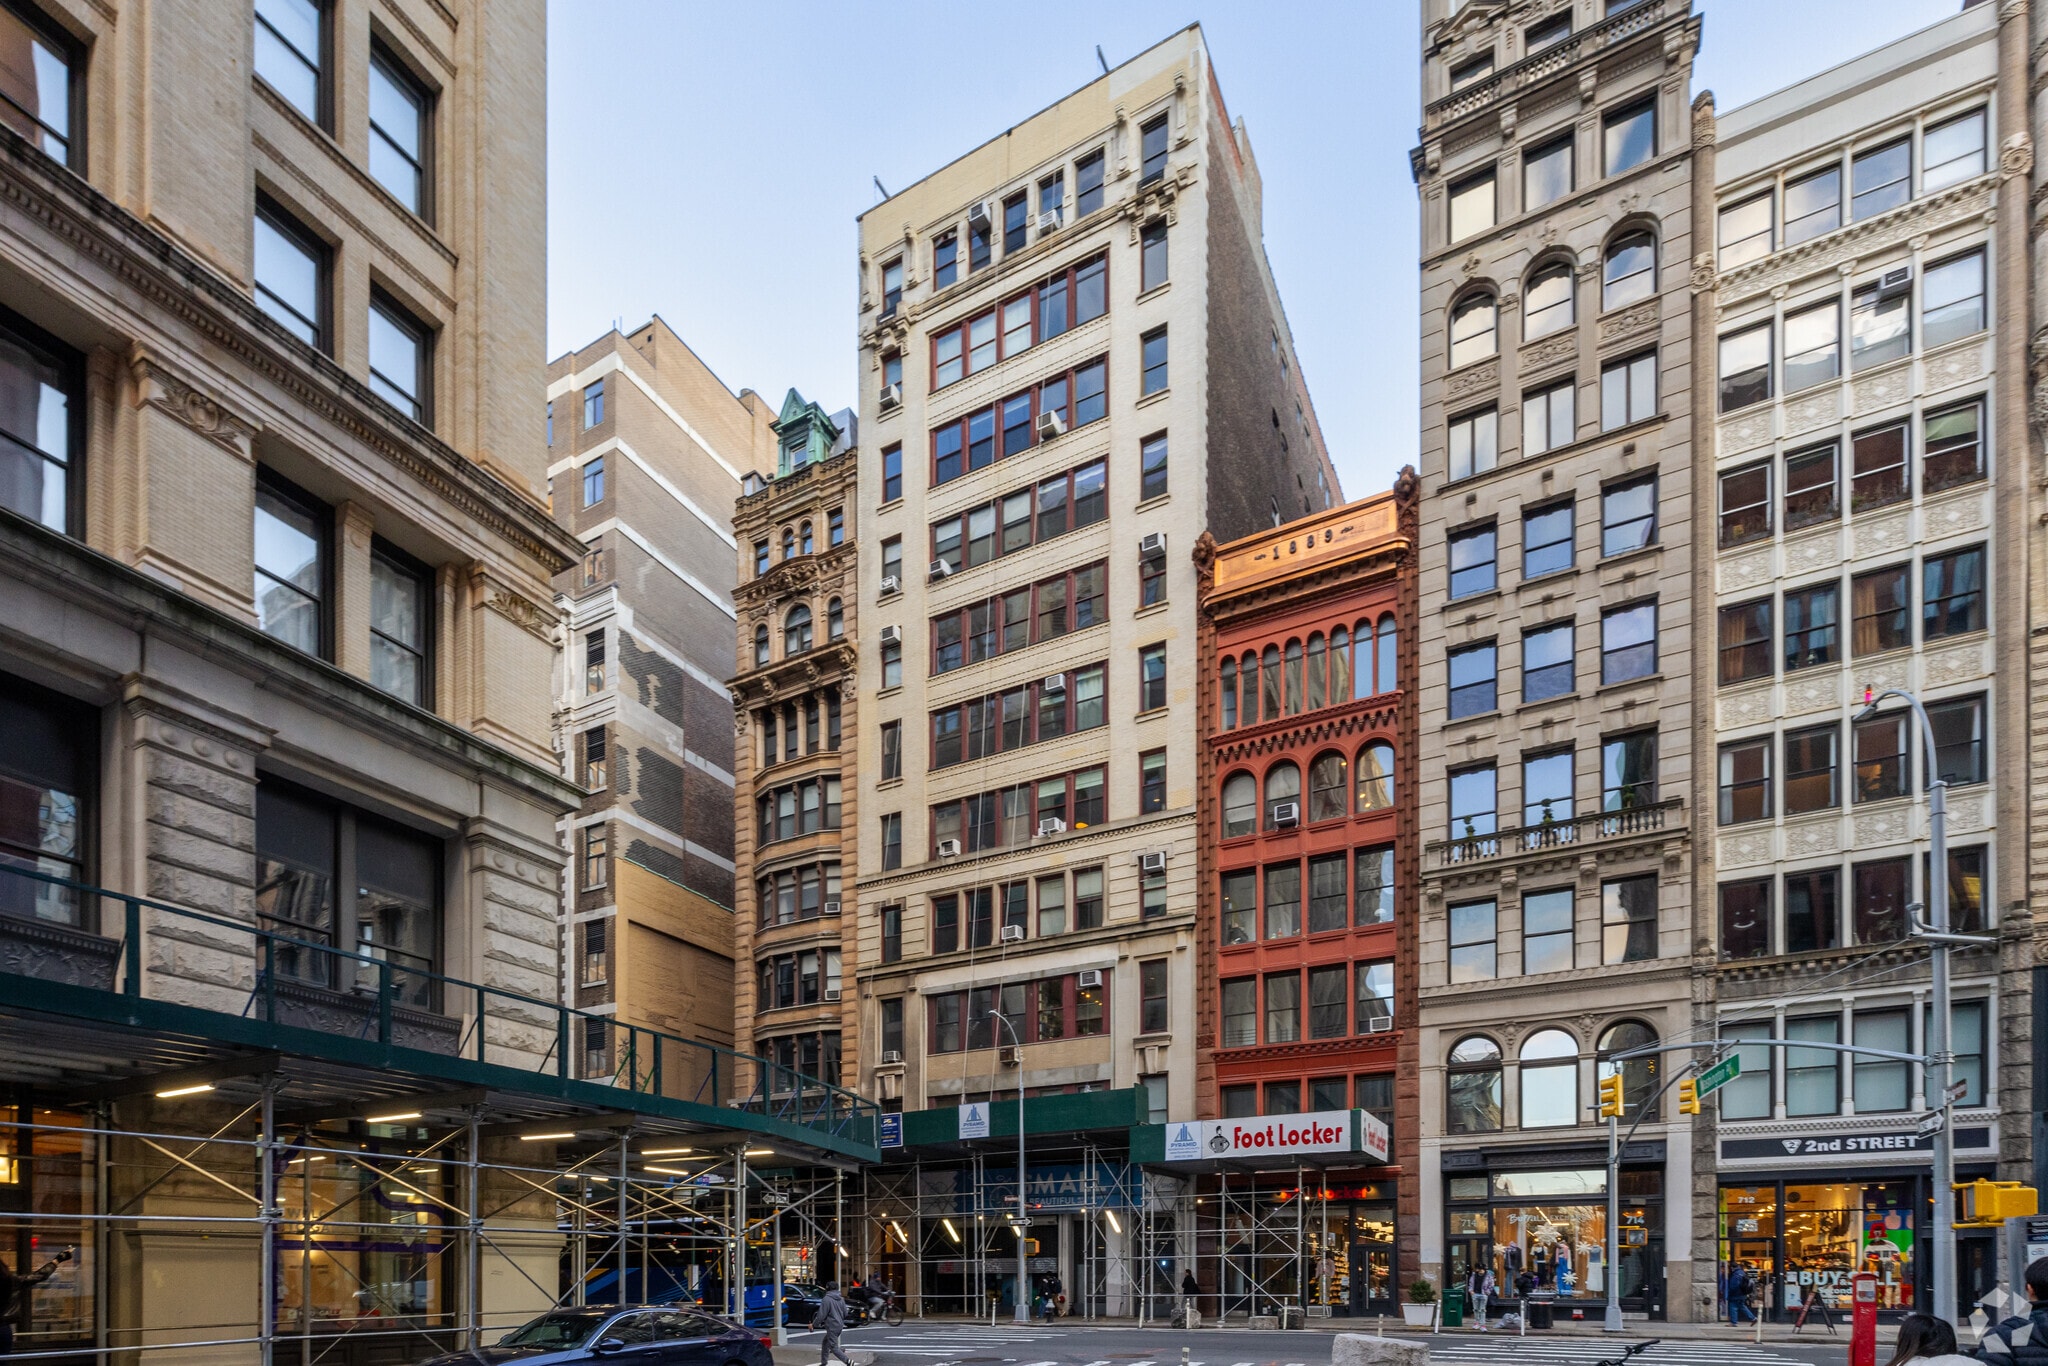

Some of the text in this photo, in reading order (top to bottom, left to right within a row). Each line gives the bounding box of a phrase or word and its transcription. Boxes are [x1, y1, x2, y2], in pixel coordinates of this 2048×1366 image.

[1272, 528, 1334, 560] 1889
[1234, 1121, 1343, 1149] Foot Locker
[1805, 1139, 1841, 1152] 2nd
[1846, 1135, 1919, 1150] STREET
[1737, 1196, 1756, 1204] 712
[1460, 1219, 1477, 1227] 714
[1626, 1215, 1645, 1224] 714
[1798, 1270, 1842, 1286] BUY
